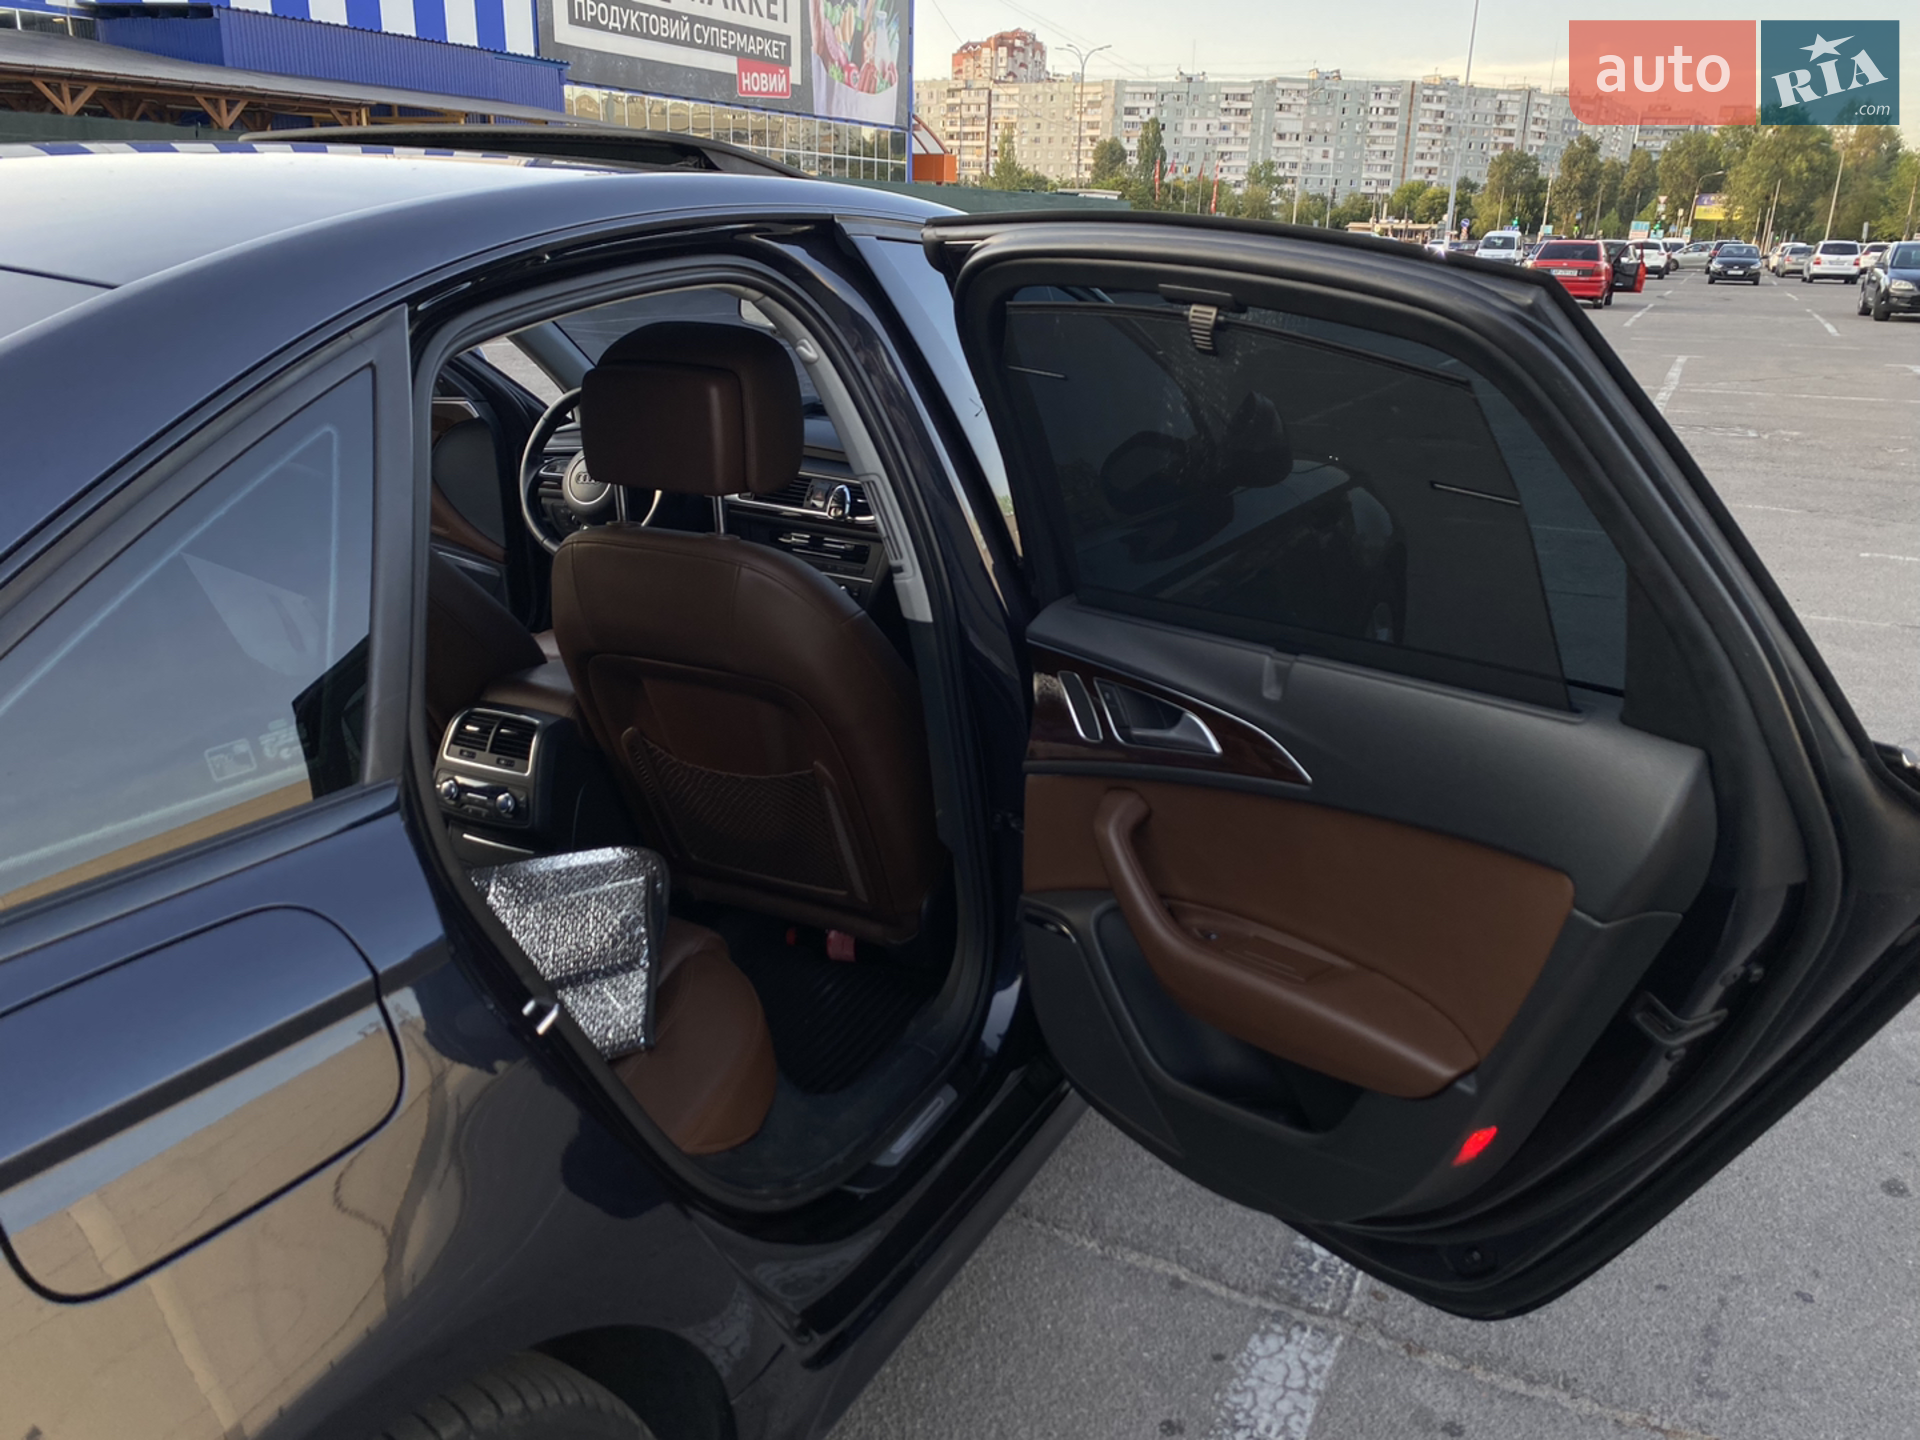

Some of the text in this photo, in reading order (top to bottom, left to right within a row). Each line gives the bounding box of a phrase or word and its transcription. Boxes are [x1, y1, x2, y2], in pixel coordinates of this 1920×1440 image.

[690, 0, 788, 23] KET
[574, 0, 787, 60] ПРОДУКТОВИЙ СУПЕРМАРКЕТ
[741, 69, 787, 93] НОВИЙ
